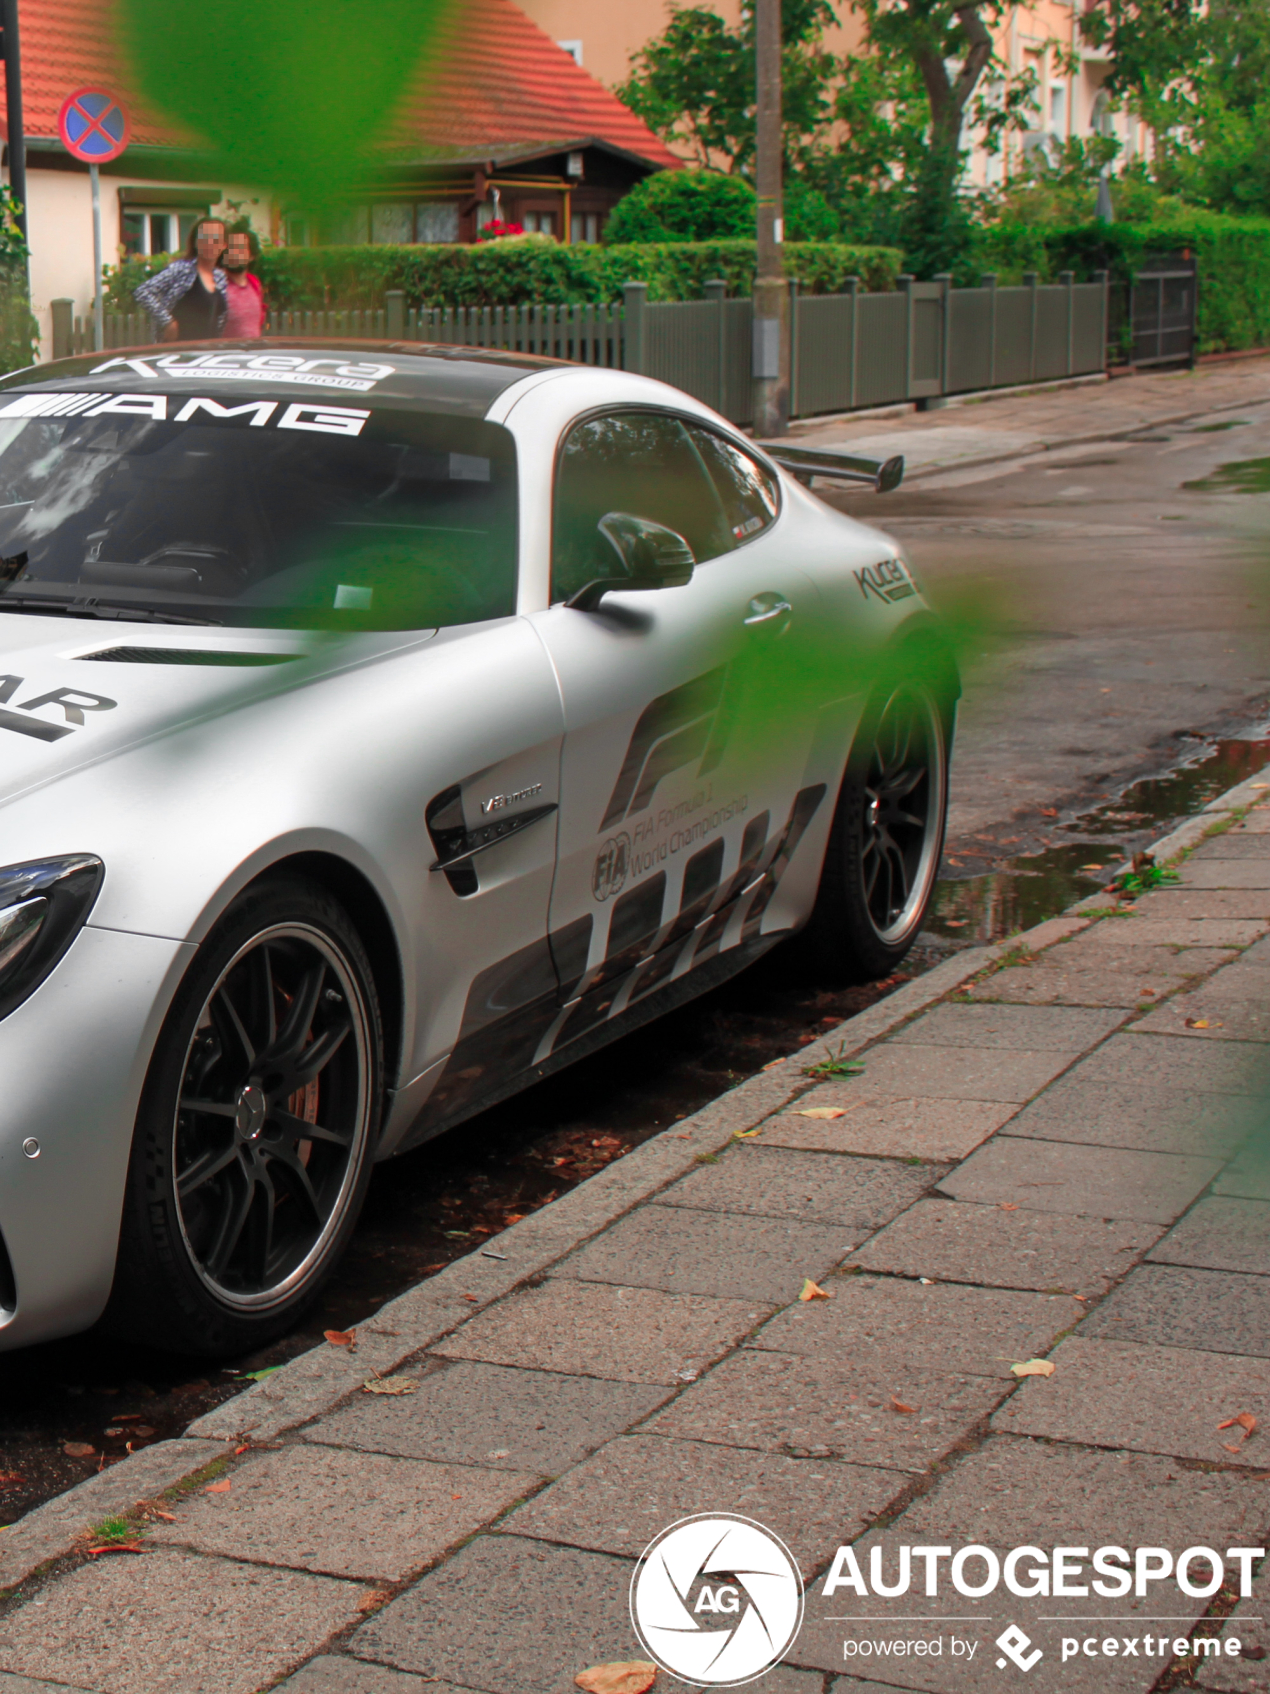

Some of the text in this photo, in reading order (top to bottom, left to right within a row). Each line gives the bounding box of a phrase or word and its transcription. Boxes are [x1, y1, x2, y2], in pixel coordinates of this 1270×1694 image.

[181, 369, 365, 388] LOGISTICS GROUP
[82, 393, 371, 436] AMG
[481, 794, 505, 814] V8
[634, 816, 655, 846] FIA
[657, 789, 707, 831] Formula
[630, 794, 749, 878] World Championship
